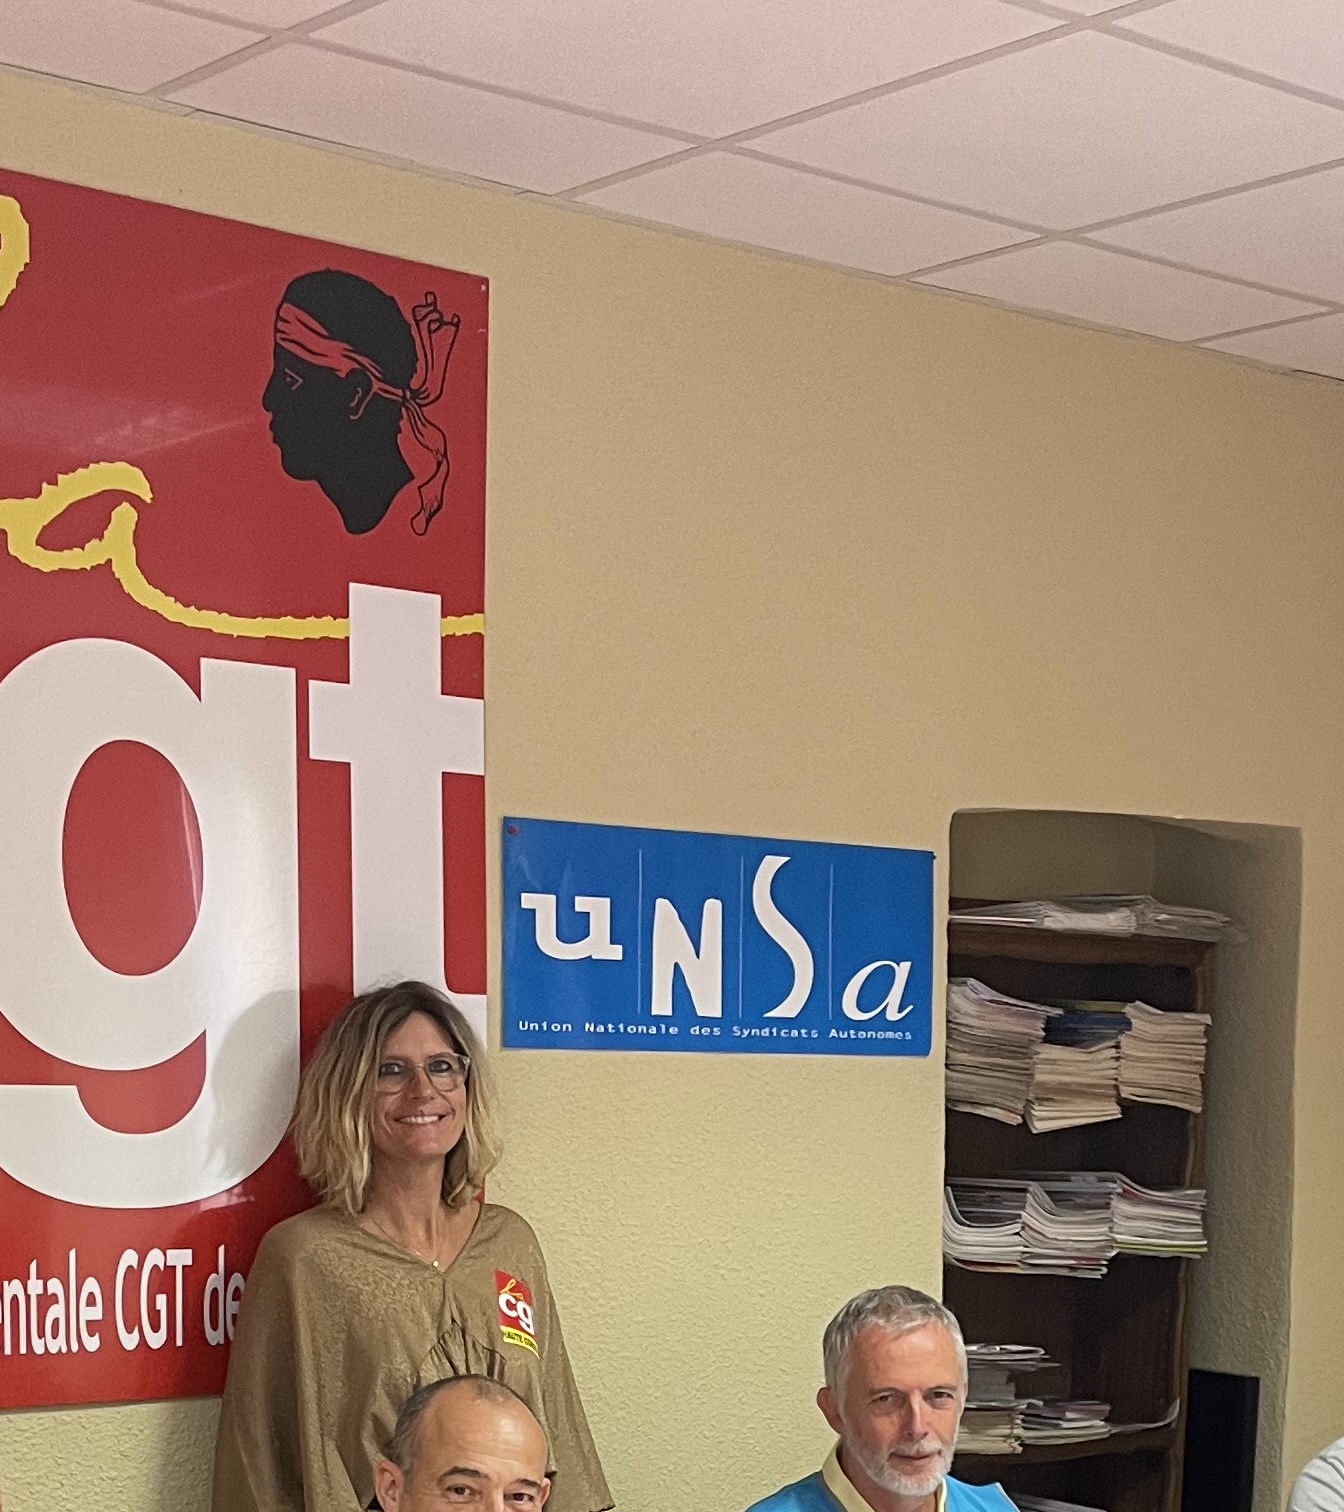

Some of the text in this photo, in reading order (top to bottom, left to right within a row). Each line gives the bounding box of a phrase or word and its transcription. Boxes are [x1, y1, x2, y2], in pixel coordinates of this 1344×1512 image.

[518, 1020, 912, 1041] Union Nationale des Syndicats Autonomes
[115, 1248, 193, 1351] CGT
[498, 1293, 535, 1336] cg
